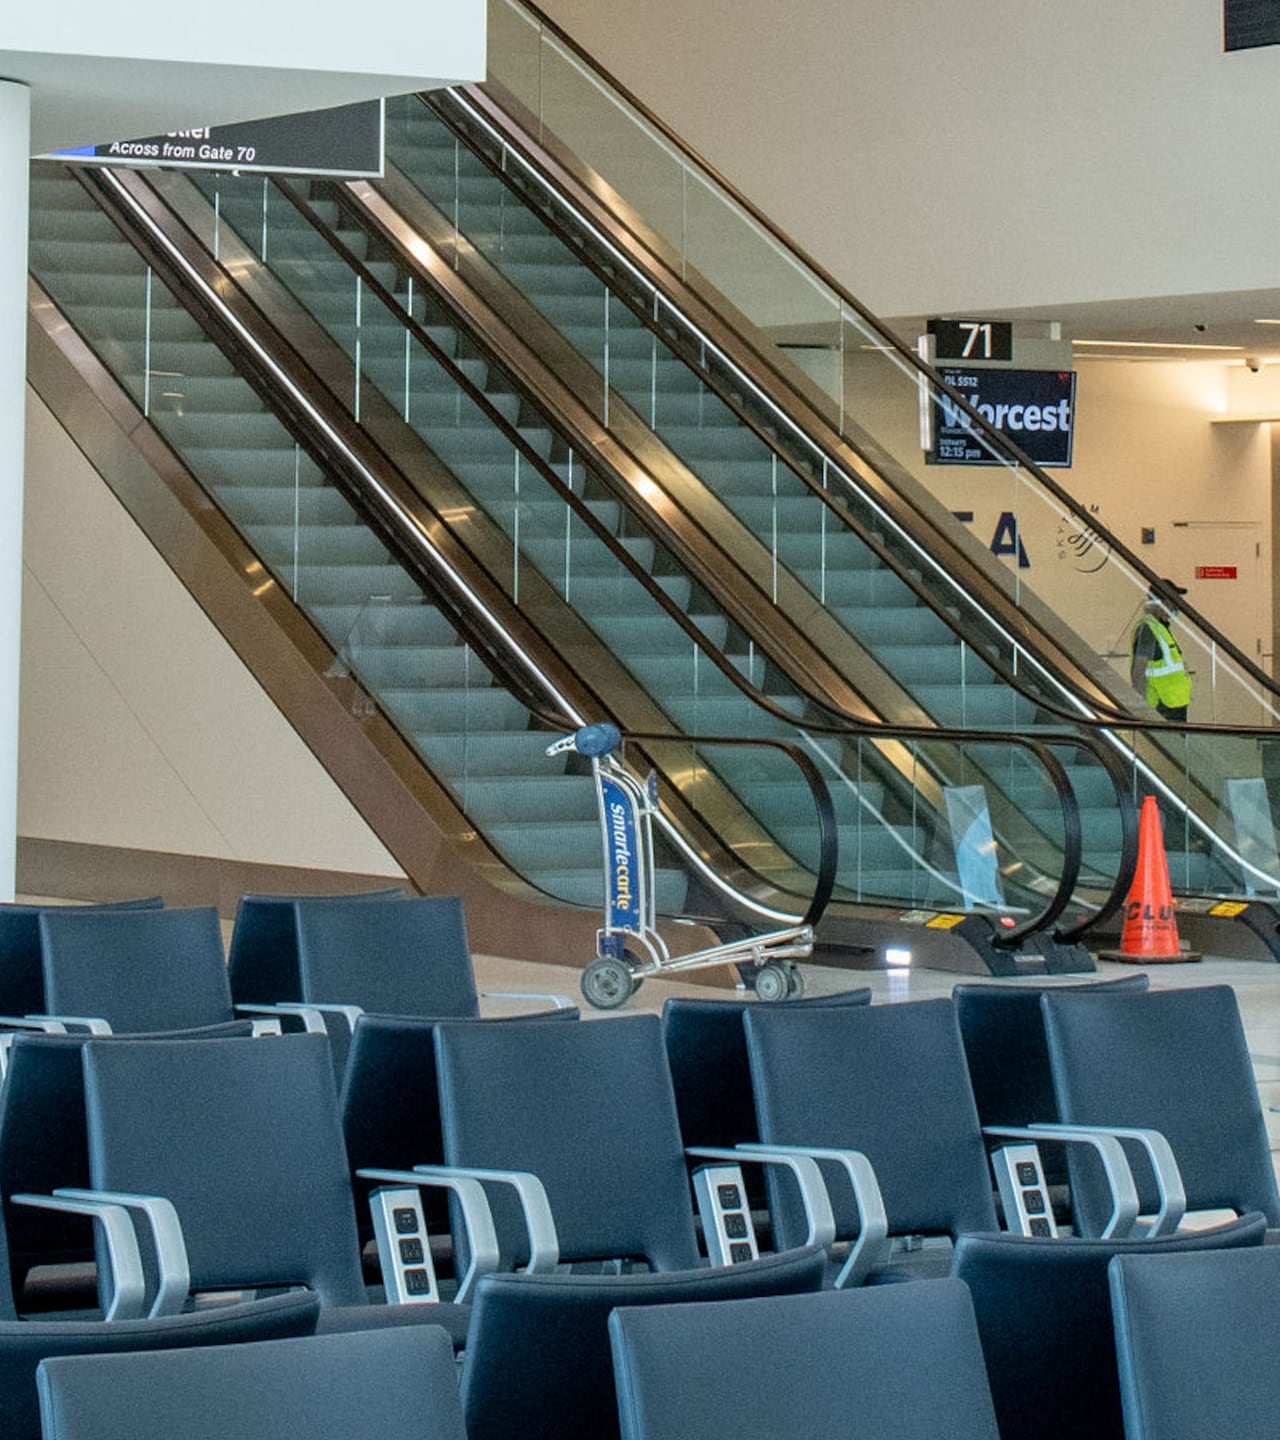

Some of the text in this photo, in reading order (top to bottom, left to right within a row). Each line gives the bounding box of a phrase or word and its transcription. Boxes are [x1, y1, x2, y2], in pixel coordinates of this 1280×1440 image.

[109, 141, 256, 162] Across from Gate 70
[959, 323, 992, 358] 71
[939, 446, 964, 458] 12:15
